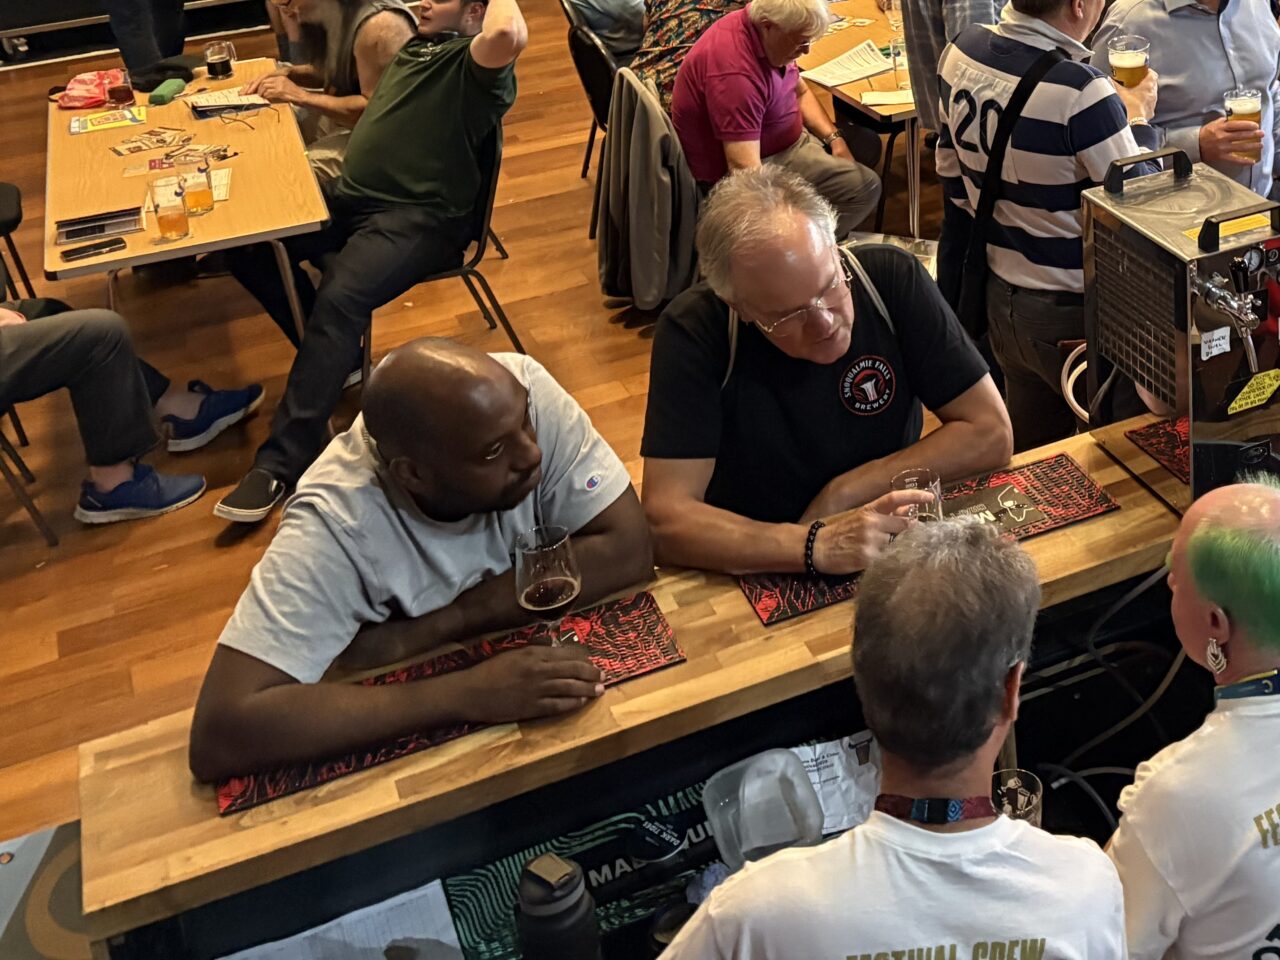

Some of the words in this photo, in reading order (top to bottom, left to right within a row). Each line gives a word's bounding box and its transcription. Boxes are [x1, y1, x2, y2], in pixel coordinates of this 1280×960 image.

[953, 88, 1006, 158] 20
[844, 360, 873, 398] SNOQUALMIE
[875, 361, 890, 380] FALLS
[855, 389, 890, 410] BREWERY
